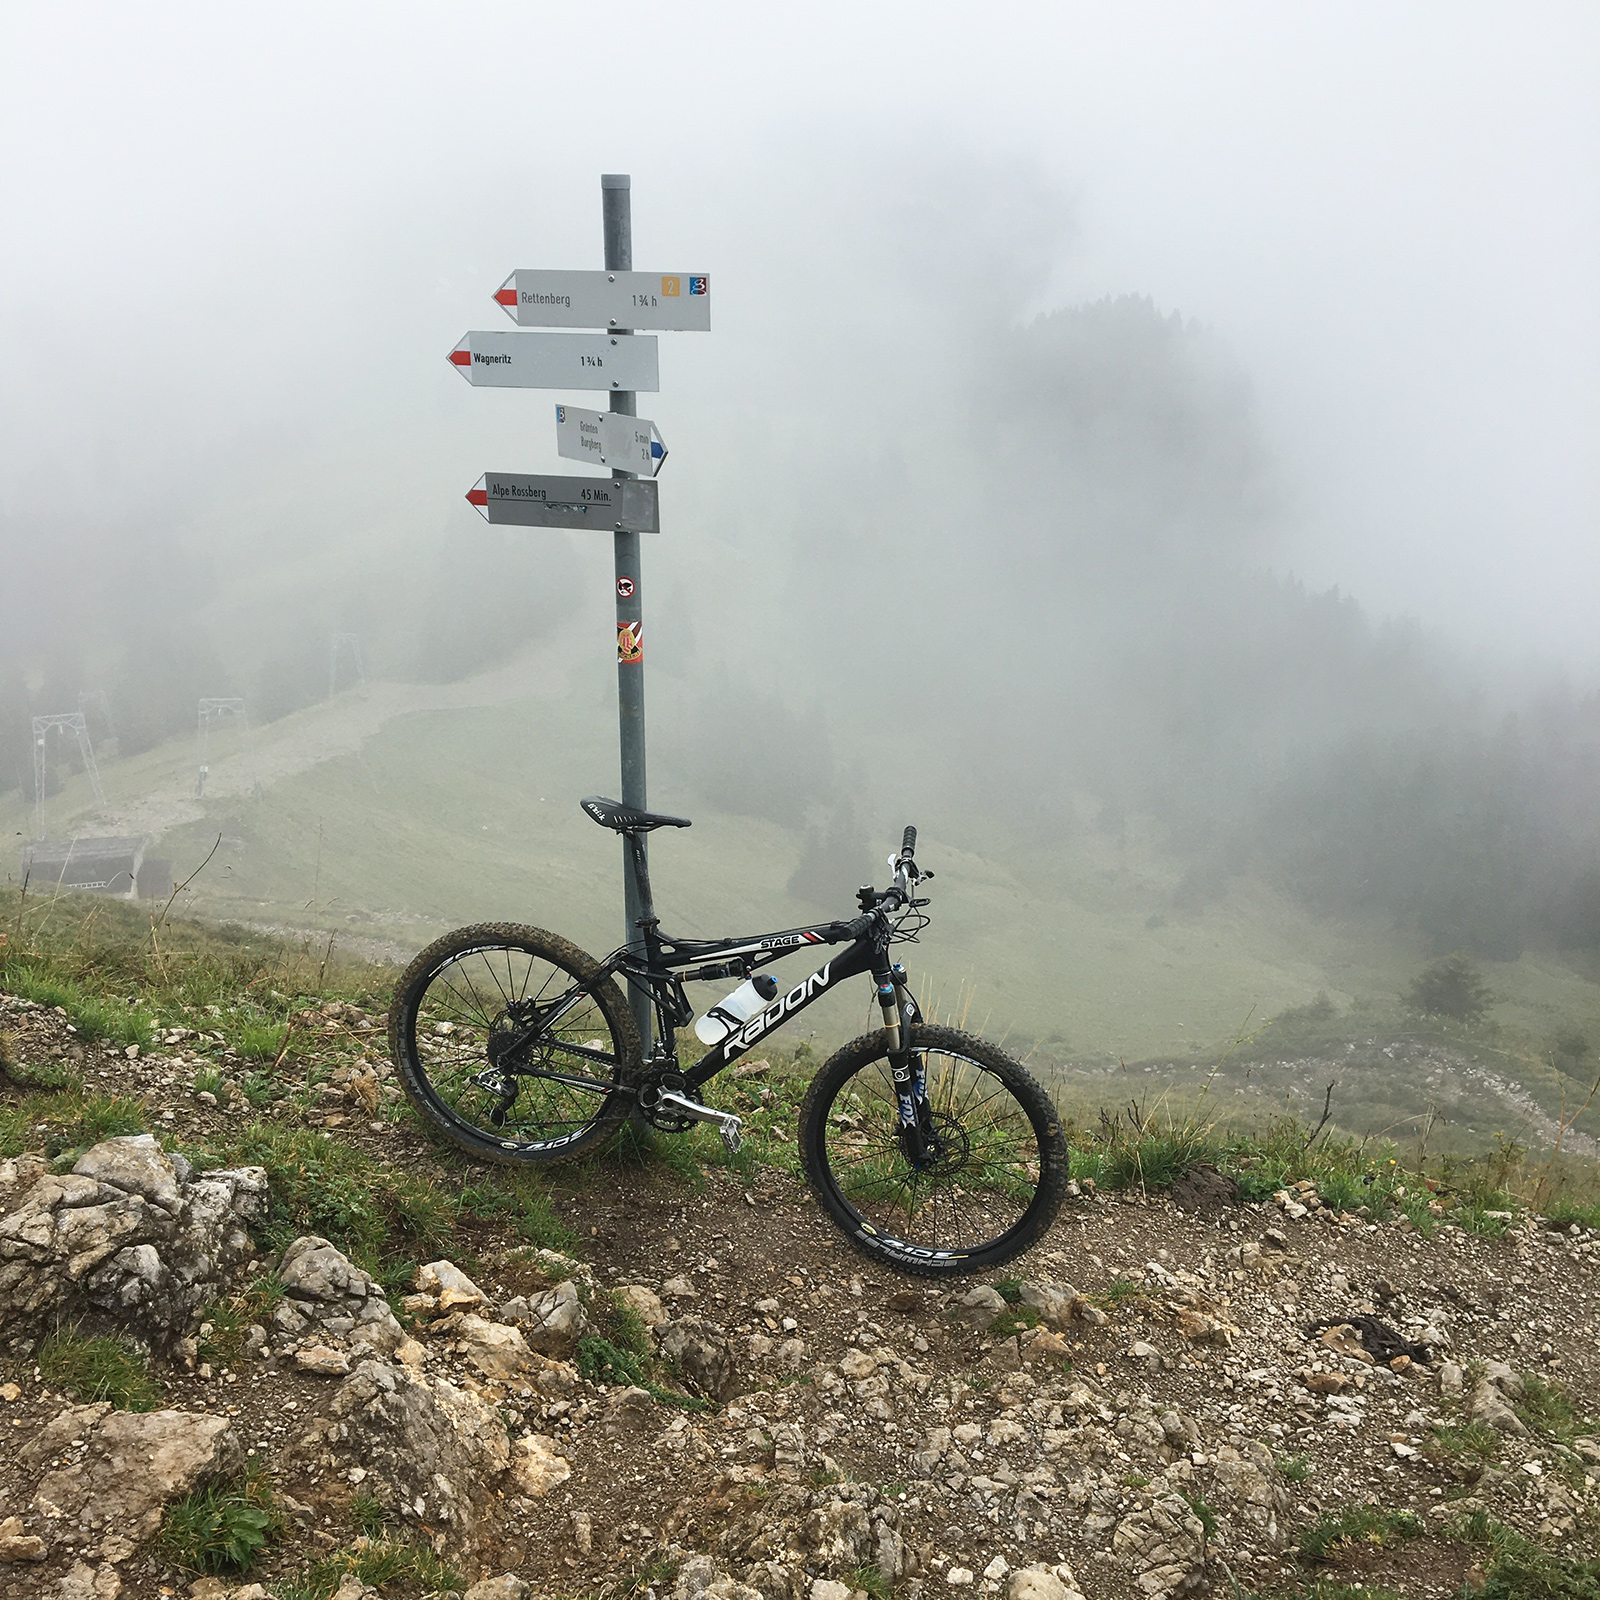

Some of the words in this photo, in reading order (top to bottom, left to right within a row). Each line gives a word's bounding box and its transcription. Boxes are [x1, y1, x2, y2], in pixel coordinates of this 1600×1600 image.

[667, 280, 674, 294] 2
[521, 292, 571, 307] Rettenberg
[651, 295, 657, 307] h
[473, 352, 512, 365] Wagneritz
[597, 357, 603, 367] h
[580, 435, 602, 453] Burgberg
[639, 434, 649, 445] min
[492, 484, 510, 498] Alpe
[512, 484, 547, 500] Rossberg
[581, 489, 592, 501] 45
[593, 489, 612, 502] Min.
[760, 935, 801, 949] STAGE
[899, 1093, 917, 1129] FOX
[853, 1229, 958, 1268] SCHWALBE
